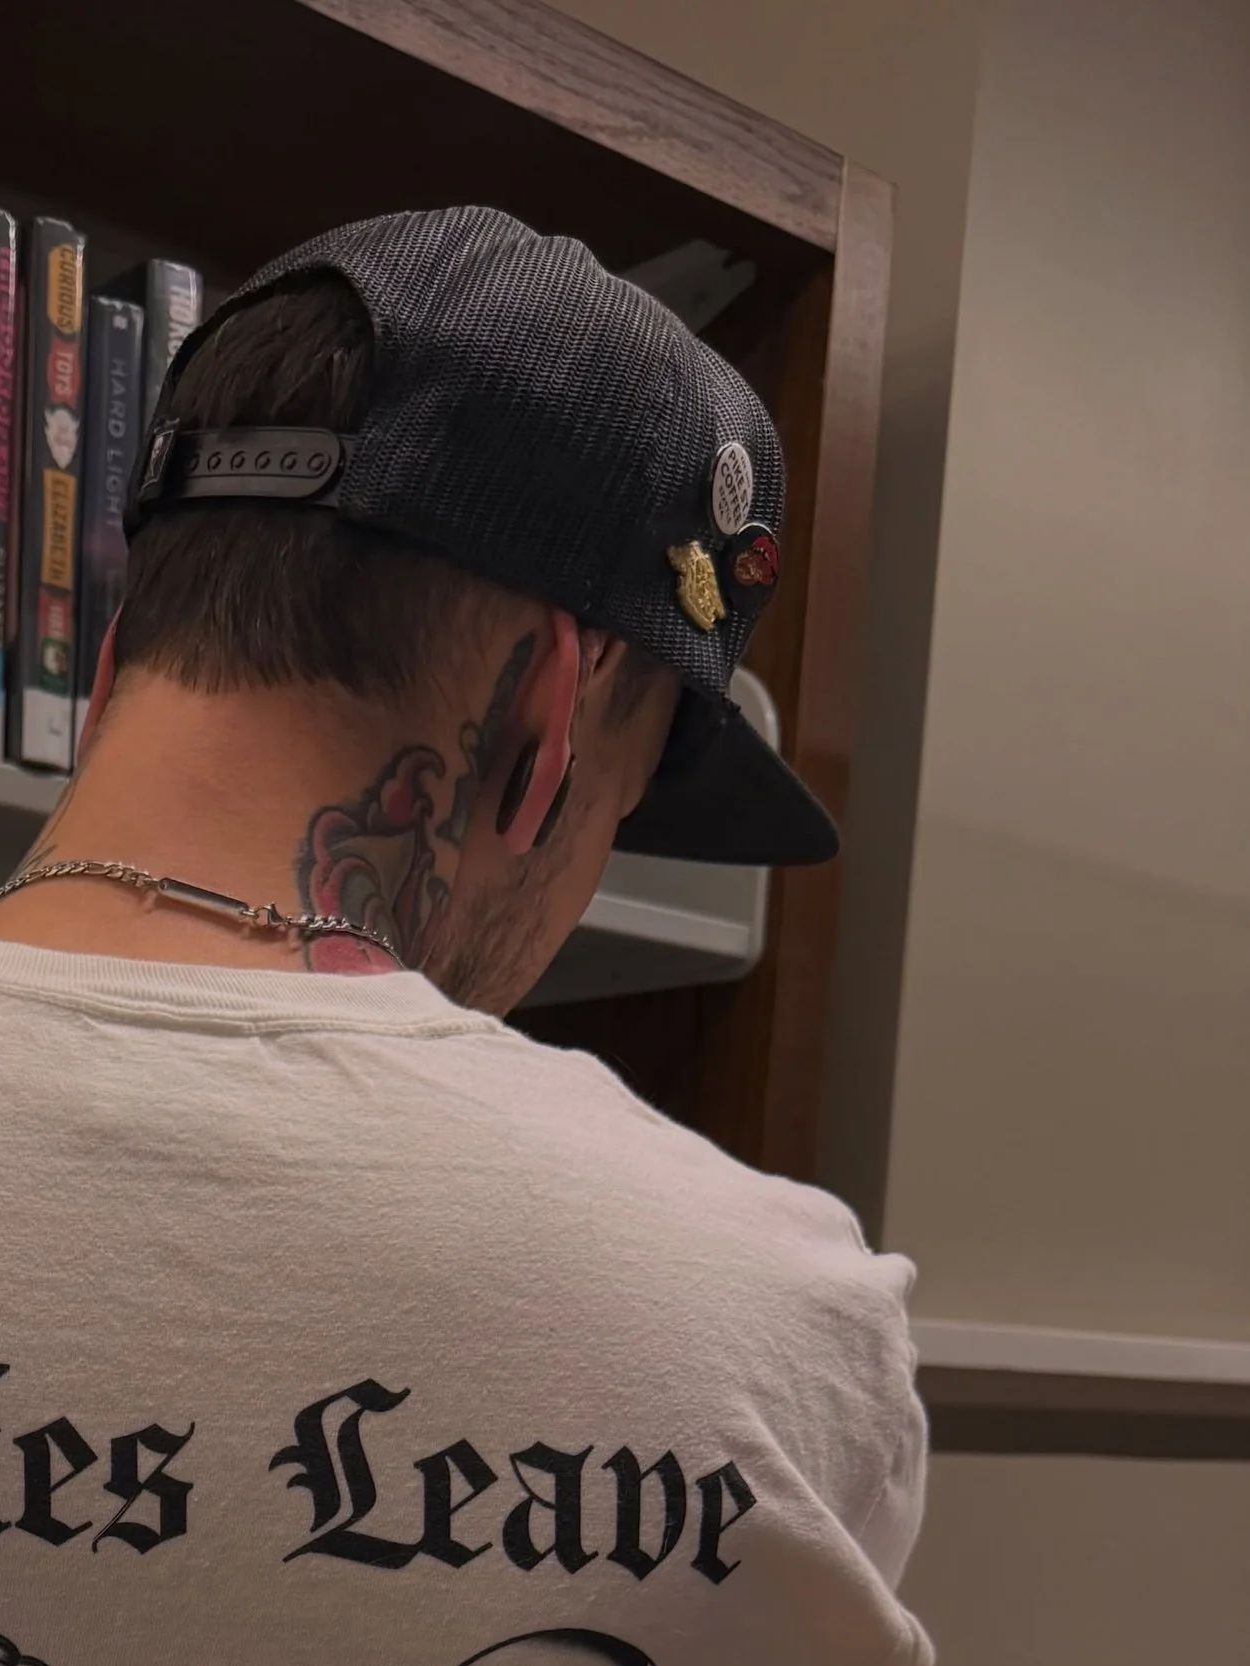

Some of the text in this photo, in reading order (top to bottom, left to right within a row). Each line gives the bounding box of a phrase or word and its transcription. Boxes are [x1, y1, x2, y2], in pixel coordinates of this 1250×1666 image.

[58, 246, 76, 333] CURIOUS
[55, 349, 73, 398] TOYS
[105, 357, 129, 531] HARD LIGHT
[50, 478, 72, 582] ELIZABETH
[721, 462, 742, 528] COFFEE
[268, 1377, 758, 1586] Leave
